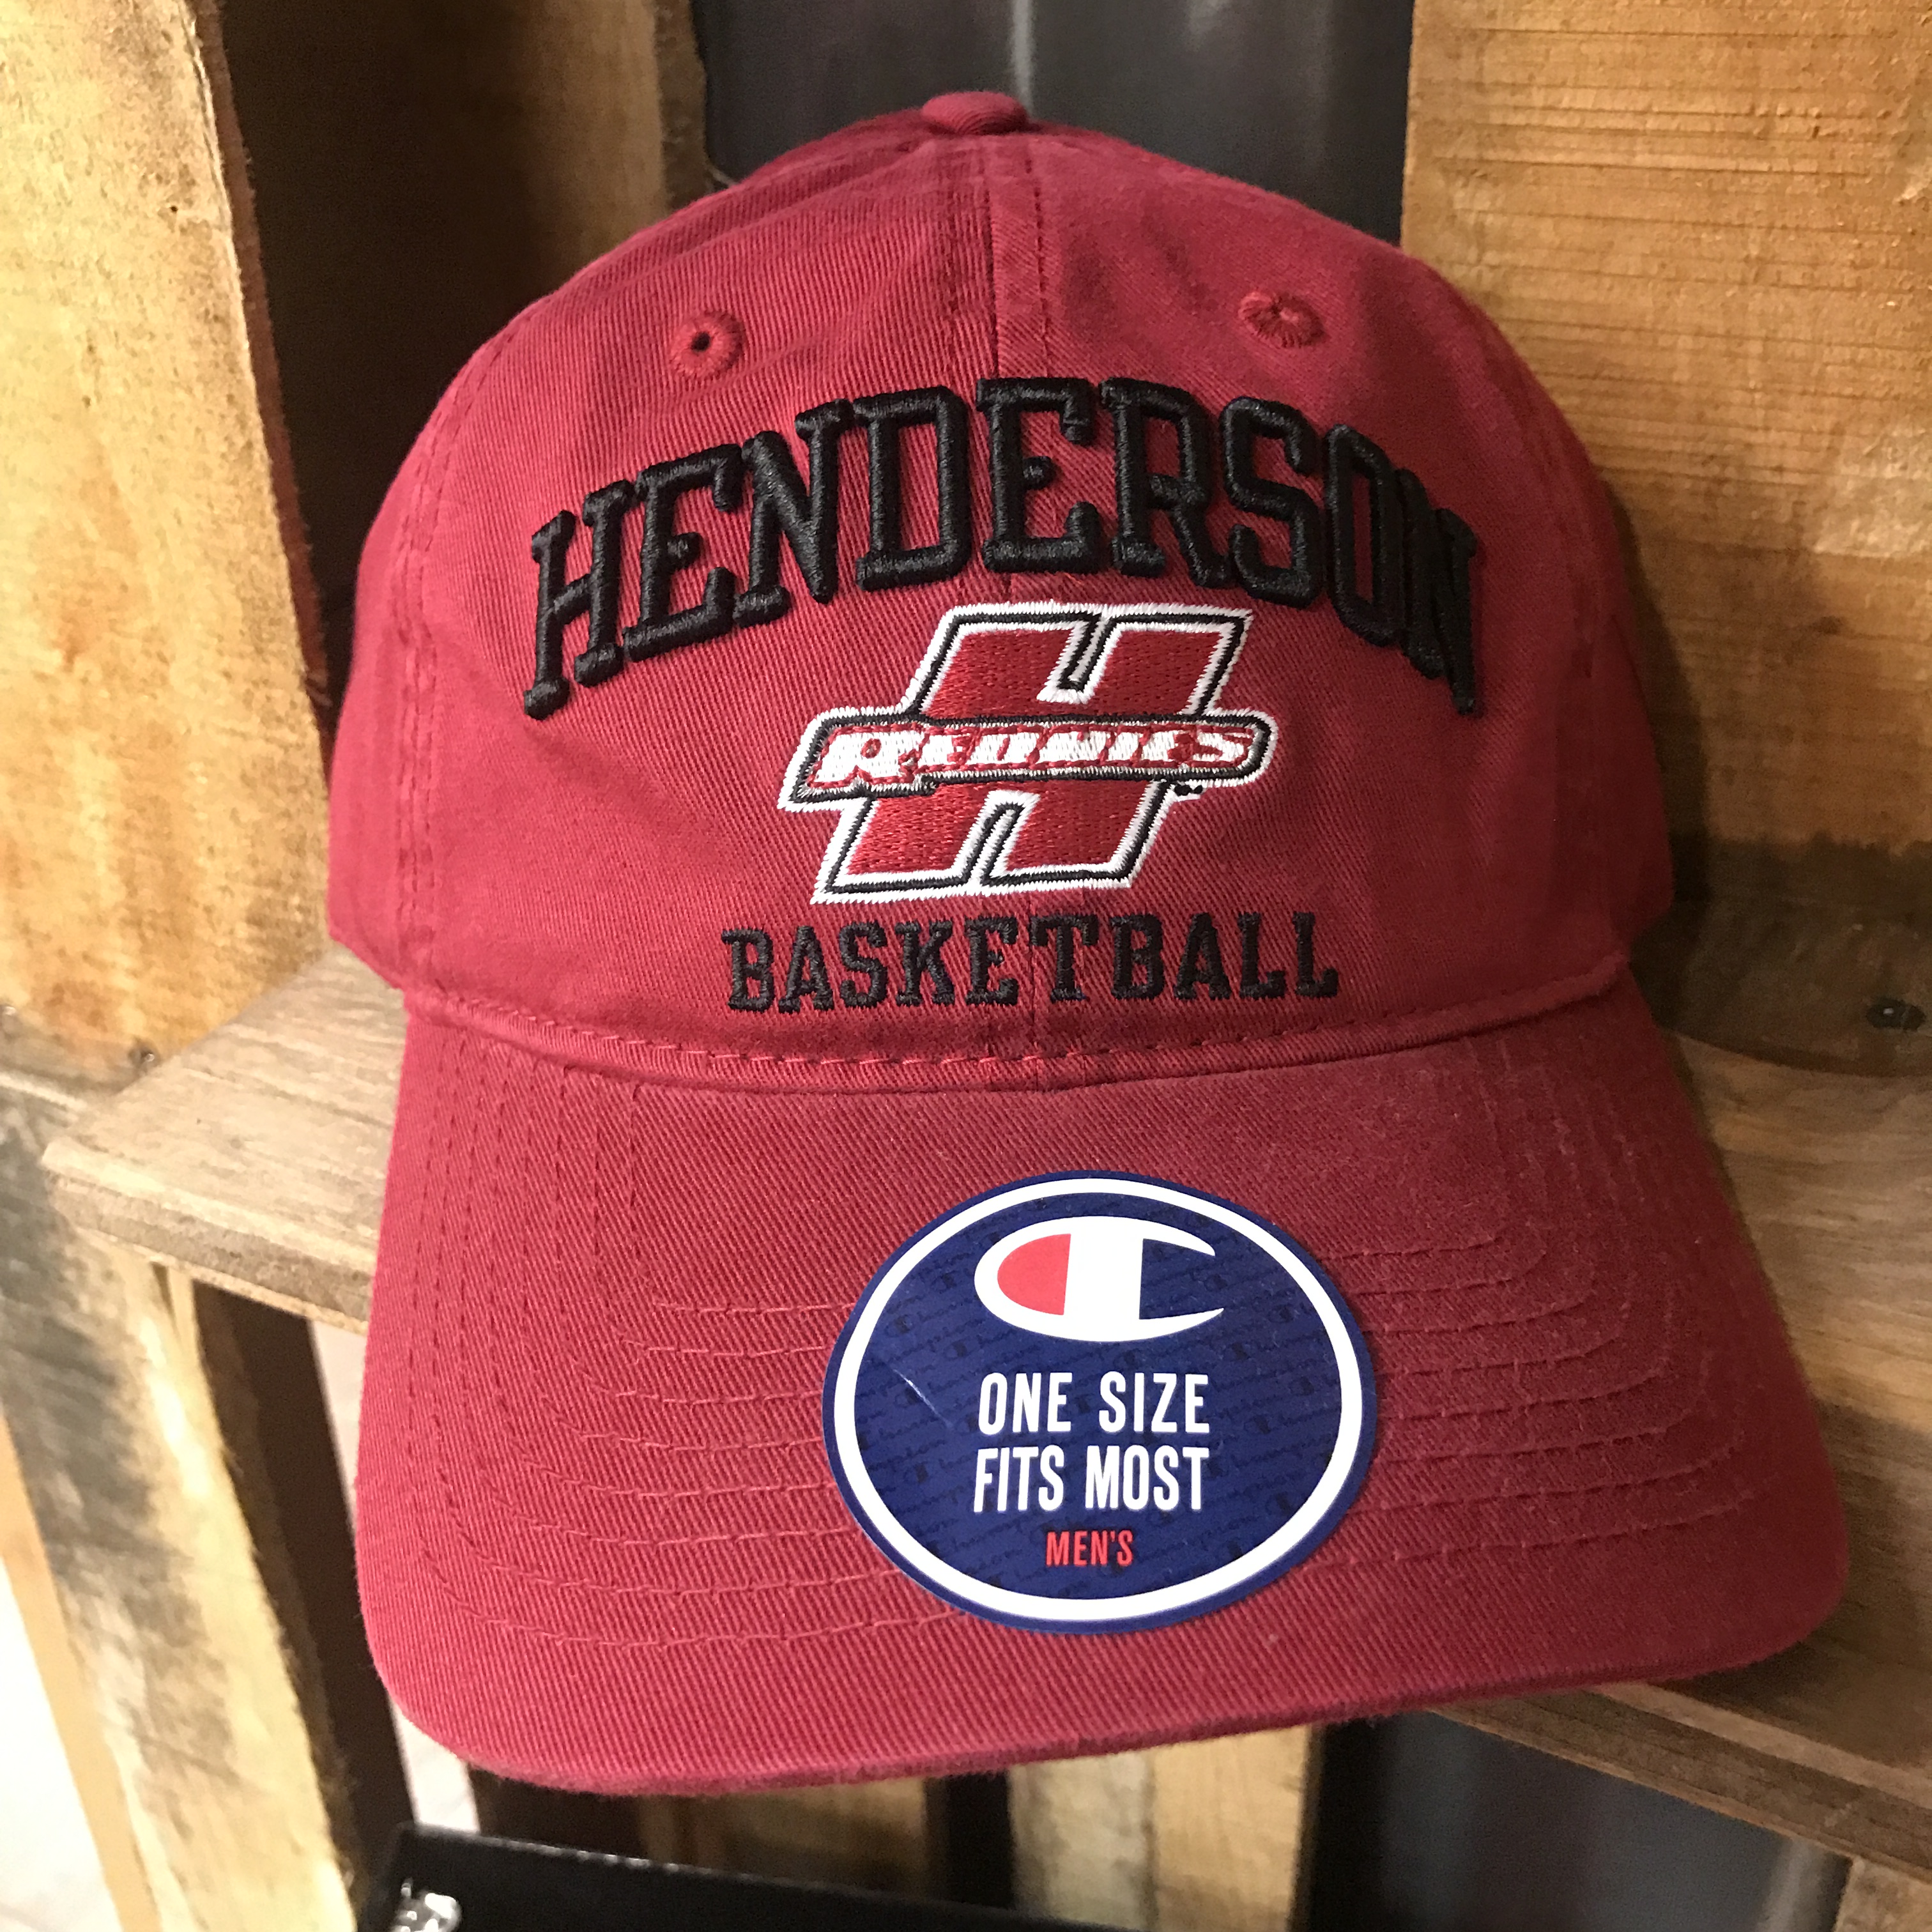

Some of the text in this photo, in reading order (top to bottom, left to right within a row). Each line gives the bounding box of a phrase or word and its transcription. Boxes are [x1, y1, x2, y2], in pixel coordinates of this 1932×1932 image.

[524, 378, 1478, 718] HENDERSON
[721, 912, 1340, 1014] BASKETBALL
[977, 1370, 1211, 1436] ONE SIZE
[973, 1445, 1211, 1514] FITS MOST
[1045, 1529, 1135, 1568] MEN'S
